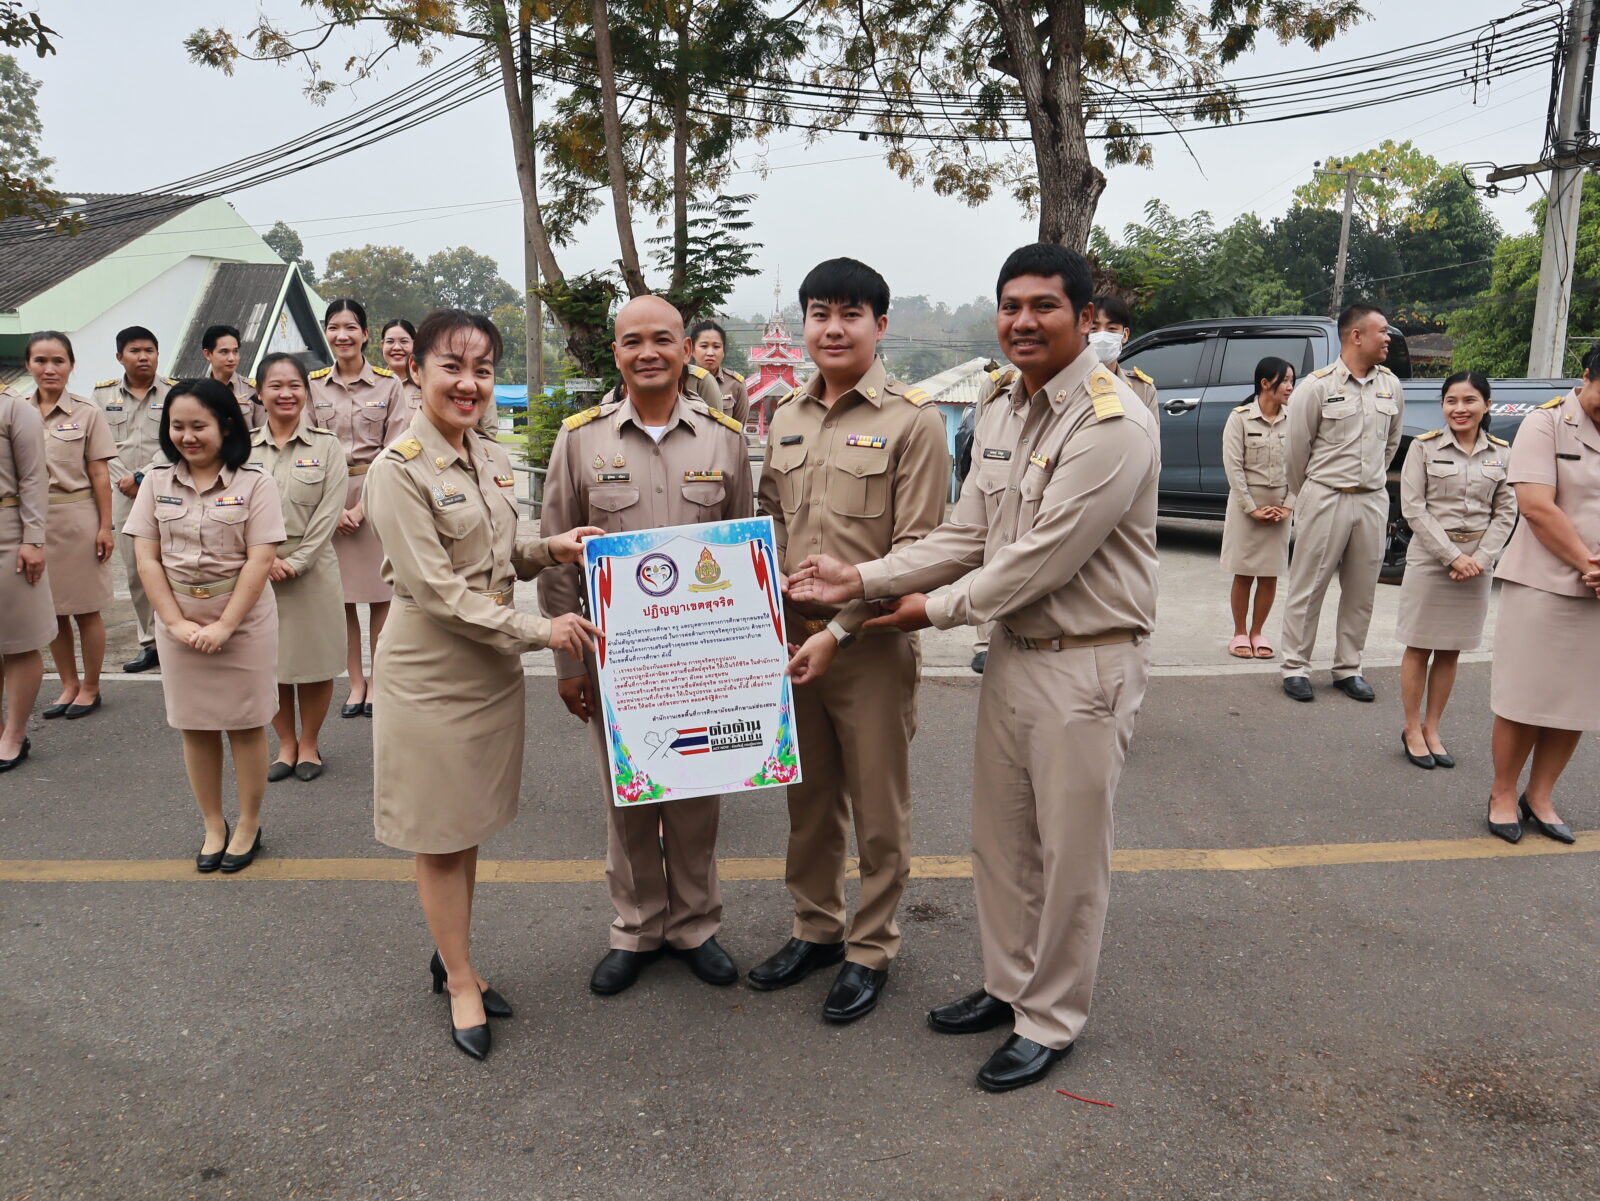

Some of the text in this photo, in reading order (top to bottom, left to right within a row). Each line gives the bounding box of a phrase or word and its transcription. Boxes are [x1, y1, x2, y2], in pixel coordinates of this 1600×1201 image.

[643, 596, 734, 619] ปฏิญญาเขตสุจริต
[709, 718, 761, 736] ต่อต้าน
